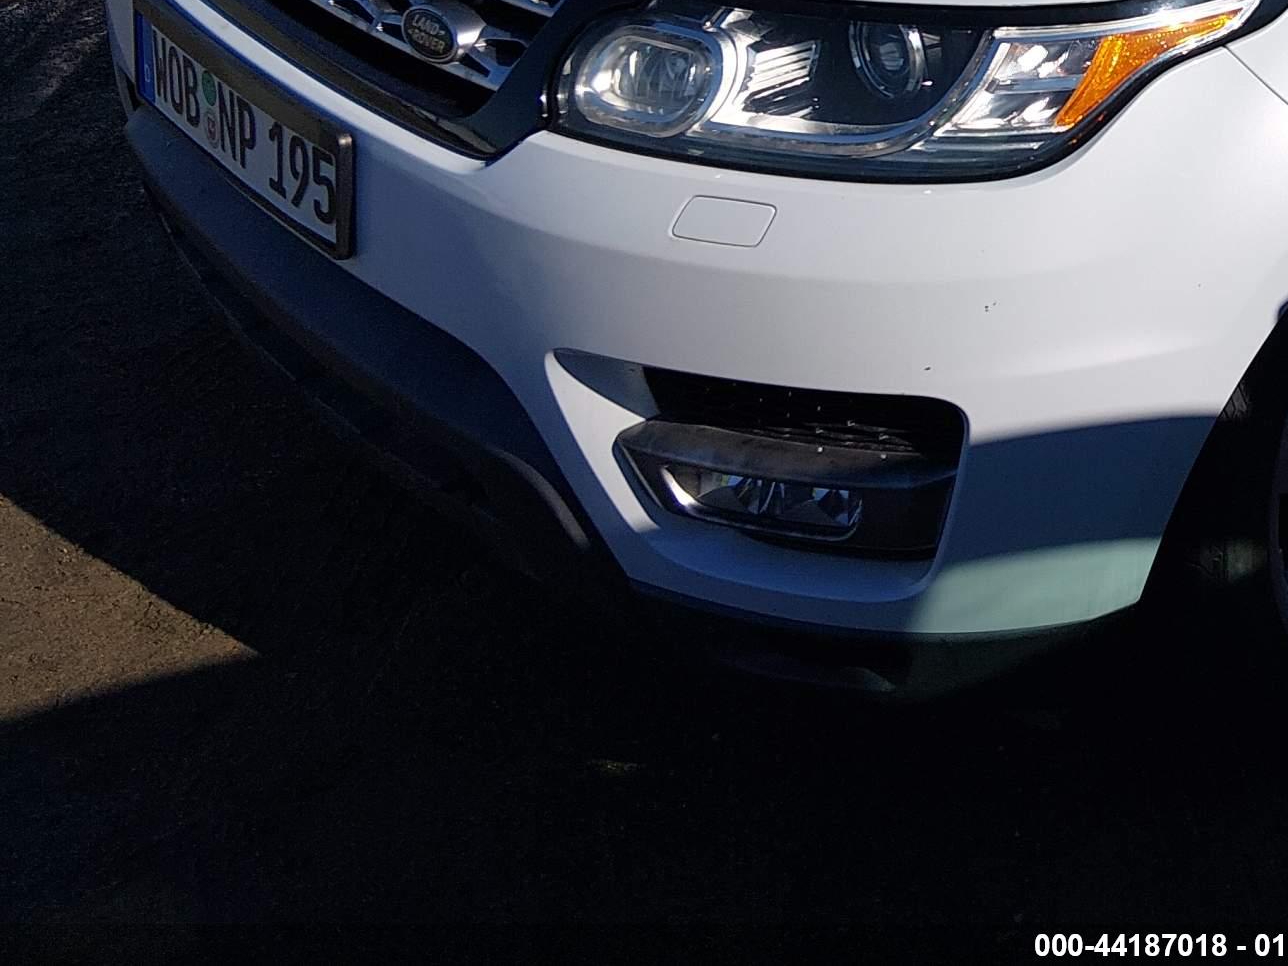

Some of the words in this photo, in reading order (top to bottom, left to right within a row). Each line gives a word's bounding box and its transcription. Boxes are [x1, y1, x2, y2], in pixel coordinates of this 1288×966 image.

[412, 14, 440, 35] LAND
[411, 30, 446, 54] ROVER
[152, 32, 201, 129] WOB
[217, 80, 257, 170] NP
[268, 120, 337, 225] 195
